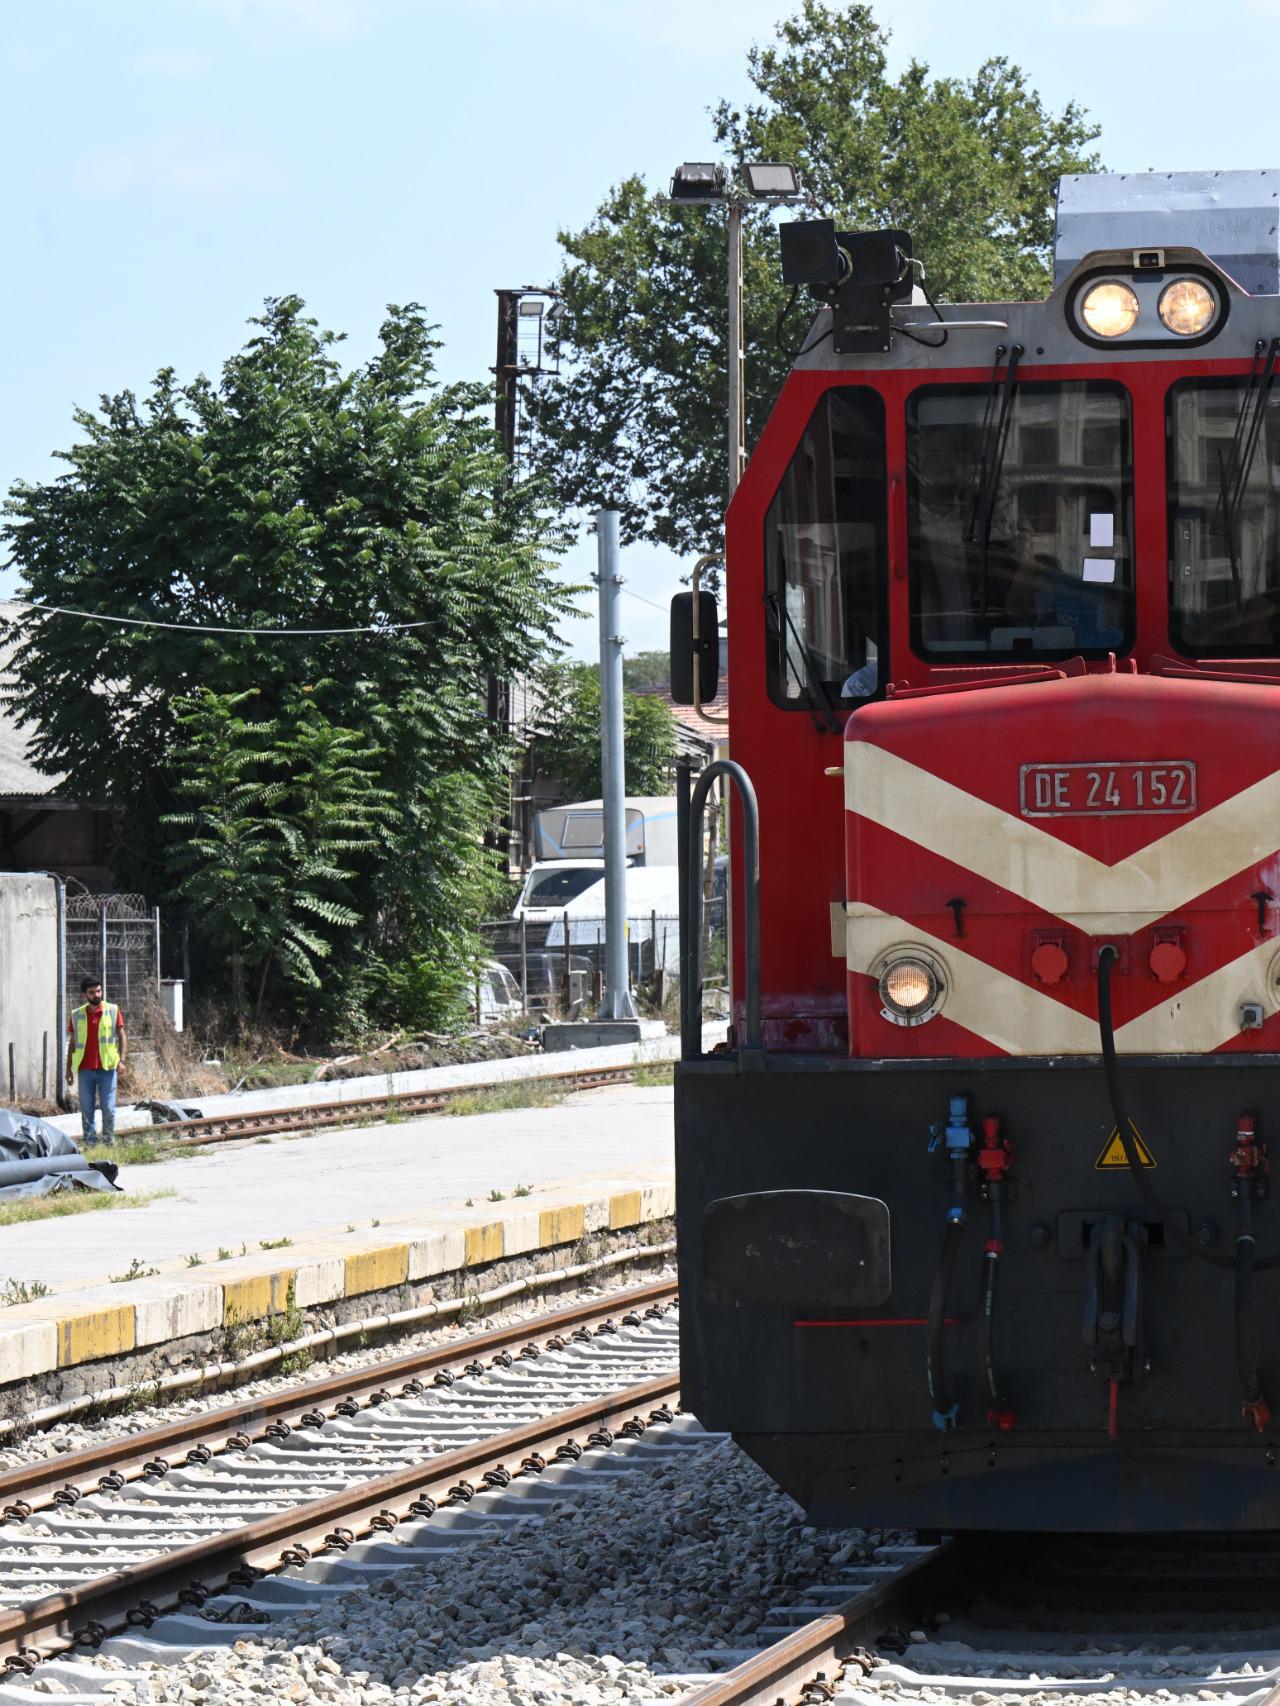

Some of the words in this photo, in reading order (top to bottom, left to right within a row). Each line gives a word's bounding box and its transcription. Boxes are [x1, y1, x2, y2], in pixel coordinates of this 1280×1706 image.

[1035, 772, 1071, 808] DE
[1086, 771, 1121, 807] 24
[1132, 769, 1188, 806] 152
